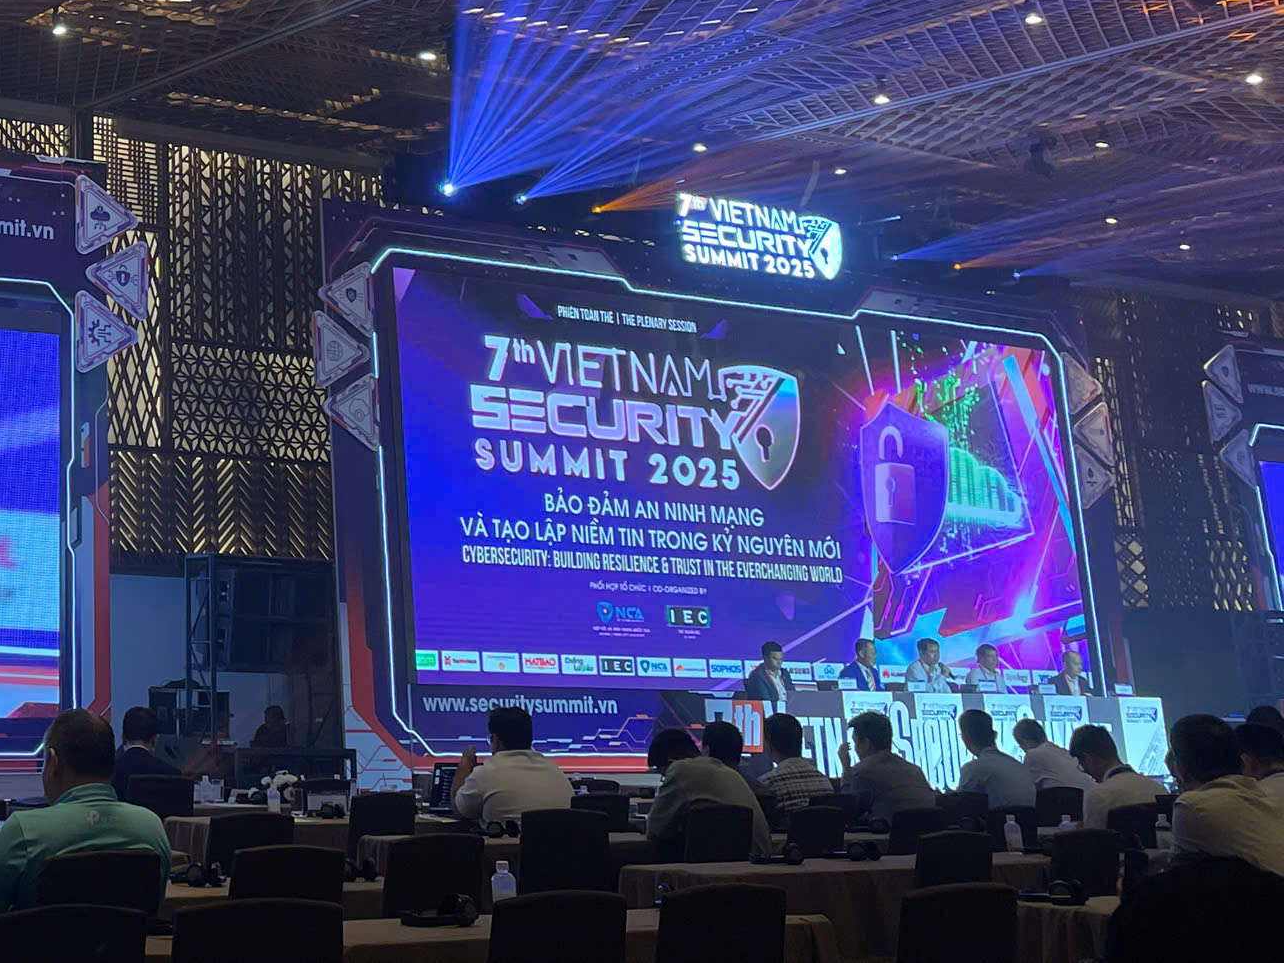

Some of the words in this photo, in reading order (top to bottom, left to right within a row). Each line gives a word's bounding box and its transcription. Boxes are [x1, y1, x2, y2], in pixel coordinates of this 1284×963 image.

[678, 192, 708, 217] 7th
[709, 198, 805, 235] VIETNAM
[682, 220, 813, 258] SECURITY
[684, 243, 759, 271] SUMMIT
[764, 254, 815, 279] 2025
[622, 313, 636, 326] THE
[637, 315, 667, 330] PLENARY
[668, 319, 697, 333] SESSION
[485, 334, 535, 381] 7th
[537, 339, 726, 401] VIETNAM
[470, 384, 734, 450] SECURITY
[474, 437, 628, 481] SUMMIT
[648, 453, 740, 490] 2025
[544, 487, 583, 514] BẢO
[587, 490, 630, 518] ĐẢM
[634, 500, 660, 521] AN
[664, 502, 706, 524] NINH
[711, 505, 764, 534] MẠNG
[459, 512, 489, 538] VÀ
[492, 518, 530, 543] TẠO
[534, 517, 566, 546] LẬP
[571, 518, 614, 545] NIỀM
[618, 526, 644, 547] TIN
[648, 528, 708, 552] TRONG
[712, 527, 733, 553] KỶ
[737, 532, 805, 558] NGUYÊN
[808, 535, 842, 560] MỚI
[462, 545, 552, 568] CYBERSECURITY:
[553, 550, 601, 571] BUILDING
[602, 553, 660, 574] RESILIENCE
[662, 558, 669, 574] &
[670, 557, 701, 577] TRUST
[703, 560, 714, 577] IN
[716, 560, 735, 579] THE
[736, 562, 809, 582] EVERCHANGING
[810, 565, 843, 584] WORLD
[615, 606, 644, 619] NCA
[710, 664, 742, 674] SOPHOS
